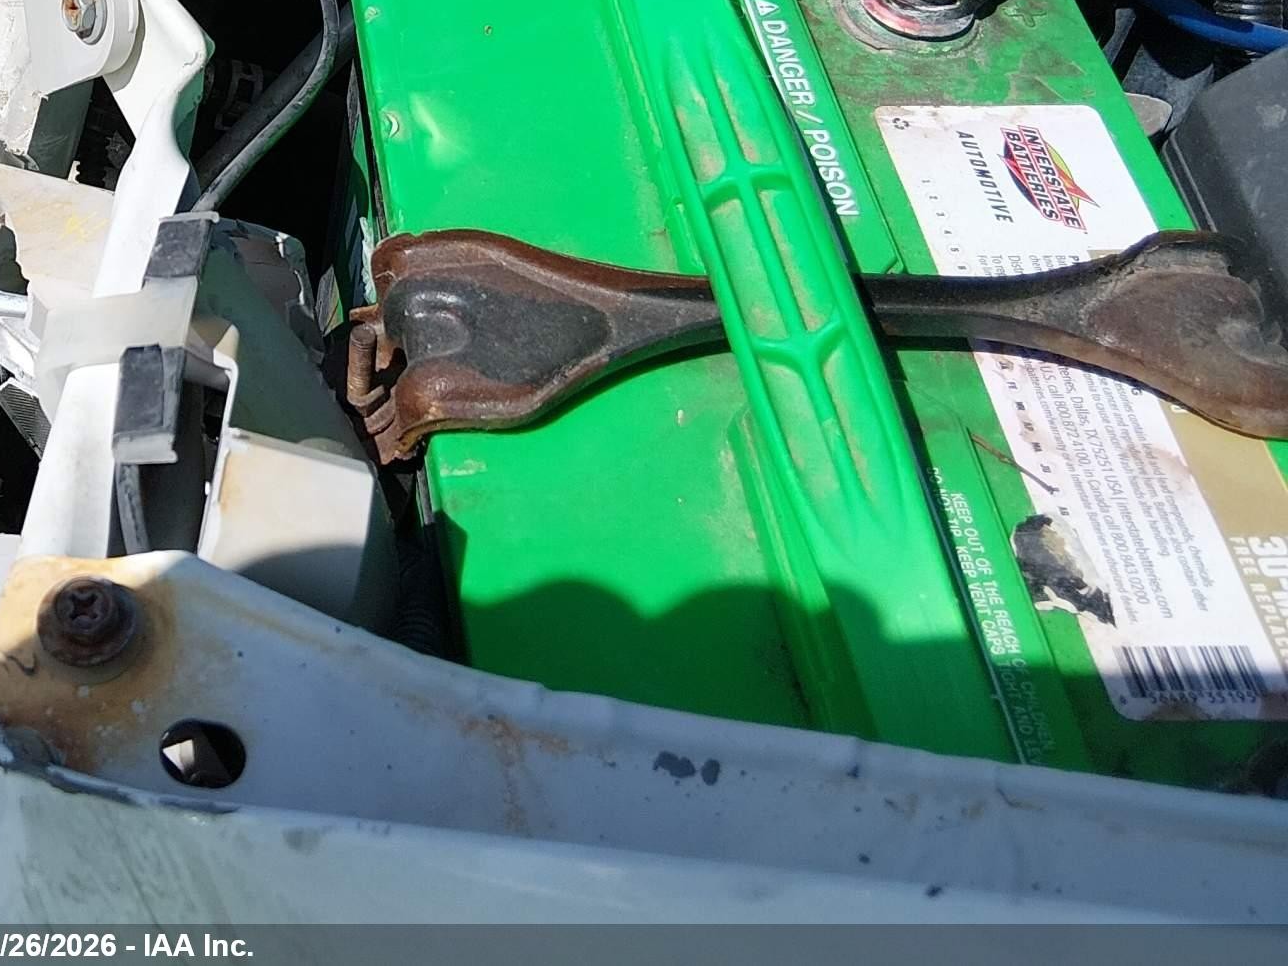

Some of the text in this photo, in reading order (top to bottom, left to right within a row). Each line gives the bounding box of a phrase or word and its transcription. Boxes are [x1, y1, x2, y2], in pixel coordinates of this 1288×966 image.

[762, 20, 816, 106] DANGER
[803, 129, 860, 217] POISON
[957, 130, 1014, 223] AUTOMOTIVE
[1006, 131, 1059, 221] BATTERIES
[1023, 128, 1081, 228] INTERSTATE
[989, 254, 1004, 264] To
[1047, 385, 1064, 398] call
[1102, 388, 1119, 410] cancer
[1070, 397, 1089, 426] Dallas,
[1112, 412, 1129, 426] and
[1054, 401, 1090, 466] 800.872.4100,
[1083, 429, 1100, 440] TX
[1127, 414, 1146, 440] contain
[1089, 442, 1113, 471] 75251
[1095, 403, 1110, 422] cause
[1117, 453, 1134, 472] Wash
[1127, 475, 1145, 498] hands
[1138, 501, 1153, 517] after
[1120, 429, 1148, 474] reproductive
[1141, 444, 1158, 458] lead
[1082, 469, 1094, 477] in
[1148, 461, 1165, 474] and
[1087, 480, 1111, 512] Canada
[1104, 475, 1124, 494] USA
[1156, 477, 1174, 493] lead
[950, 493, 973, 523] KEEP
[1102, 515, 1121, 530] call
[1153, 502, 1175, 534] Batteries
[962, 528, 984, 553] OUT
[1070, 474, 1092, 509] Interstate
[1086, 512, 1107, 545] Batteries
[1102, 548, 1128, 592] authorized
[1169, 537, 1184, 553] also
[973, 558, 993, 575] OF
[1110, 532, 1149, 604] 800.843.0200
[1117, 502, 1172, 618] interstatebatteries.com
[1177, 555, 1197, 585] contain
[1188, 546, 1214, 586] chemicals
[1229, 537, 1259, 576] FREE
[954, 546, 975, 578] KEEP
[966, 582, 989, 614] VENT
[979, 619, 1004, 654] CAPS
[981, 580, 1002, 604] THE
[1191, 589, 1208, 610] other
[992, 609, 1020, 653] REACH
